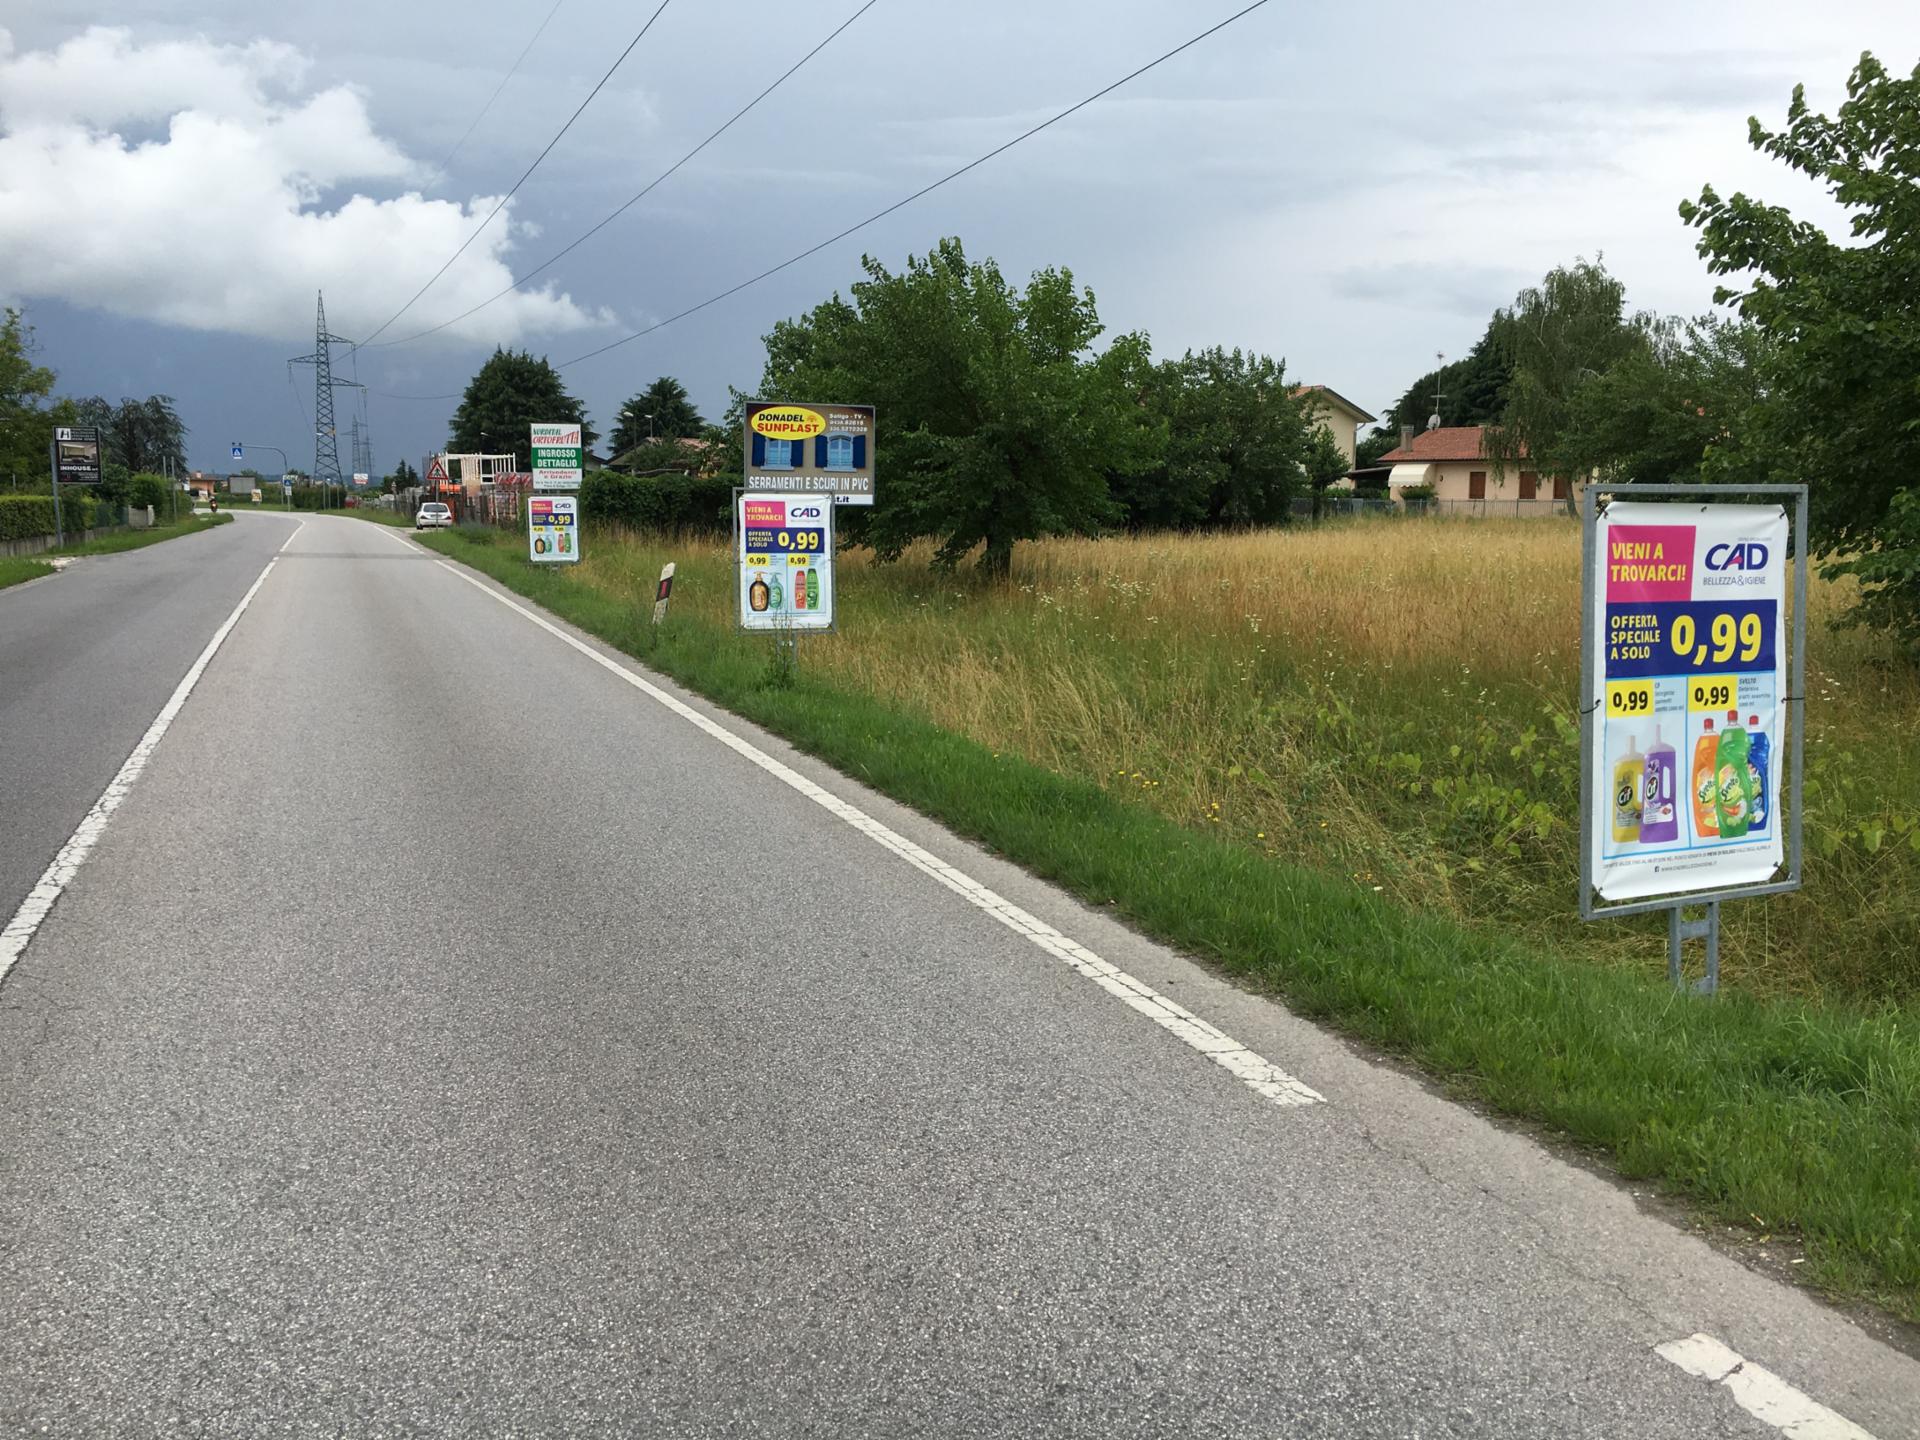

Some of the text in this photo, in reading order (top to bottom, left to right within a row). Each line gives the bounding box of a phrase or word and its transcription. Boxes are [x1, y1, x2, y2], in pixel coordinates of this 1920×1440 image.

[759, 414, 804, 422] DONADEL
[757, 423, 819, 433] SUNPLAST
[538, 449, 576, 458] INGROSSO
[537, 459, 578, 467] DETTAGLIO
[749, 476, 868, 491] SERRAMENTI E SCURI IN PVC
[791, 507, 820, 518] CAD
[778, 531, 819, 550] 0,99
[1612, 543, 1664, 560] VIENI A
[1704, 543, 1769, 571] CAD
[749, 557, 766, 565] 0,99
[790, 557, 806, 565] 0,99
[1611, 564, 1687, 582] TROVARCI!
[1611, 615, 1658, 629] OFFERTA
[1611, 630, 1661, 645] SPECIALE
[1670, 613, 1762, 666] 0,99
[1610, 646, 1650, 660] A SOLO
[1612, 690, 1649, 712] 0,99
[1694, 686, 1730, 706] 0,99
[1617, 785, 1633, 807] Cif
[1645, 779, 1658, 800] Cif
